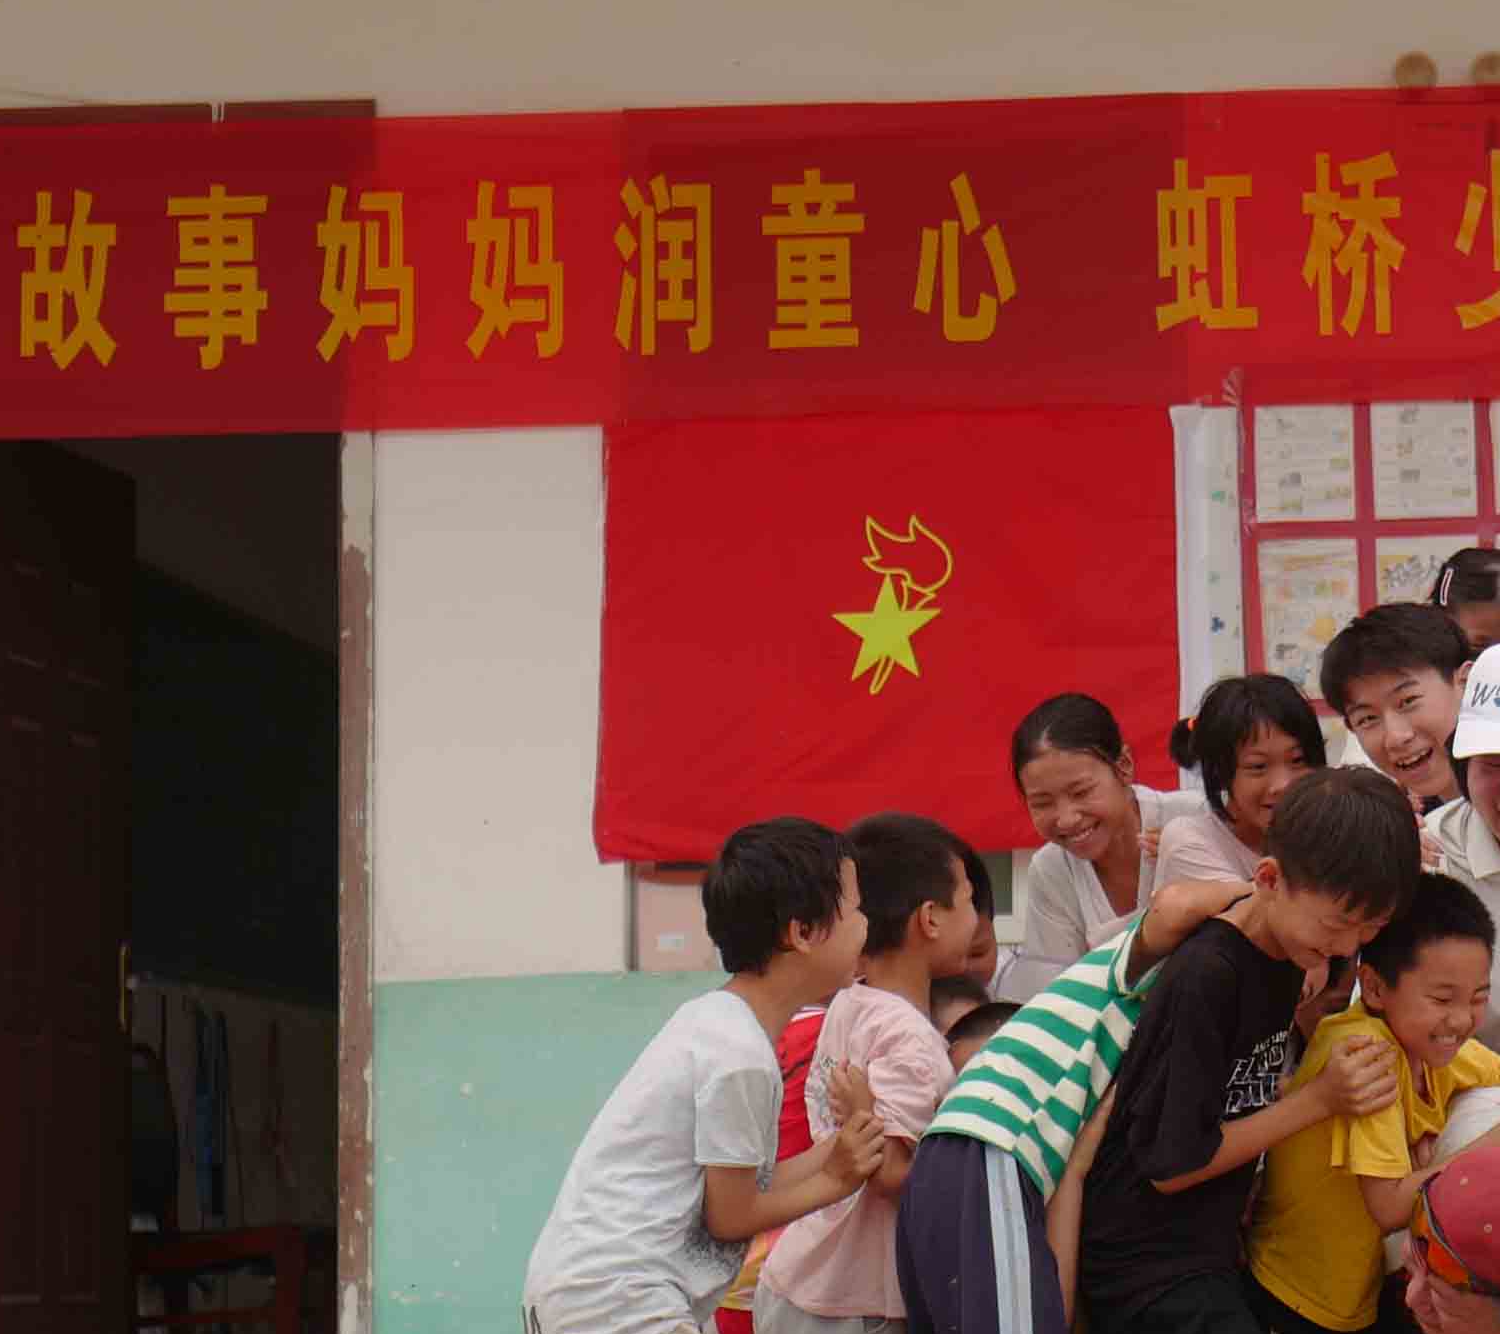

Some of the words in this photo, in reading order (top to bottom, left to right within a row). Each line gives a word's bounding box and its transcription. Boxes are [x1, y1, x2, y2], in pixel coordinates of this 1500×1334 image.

[17, 167, 1018, 371] 故事妈妈润童心
